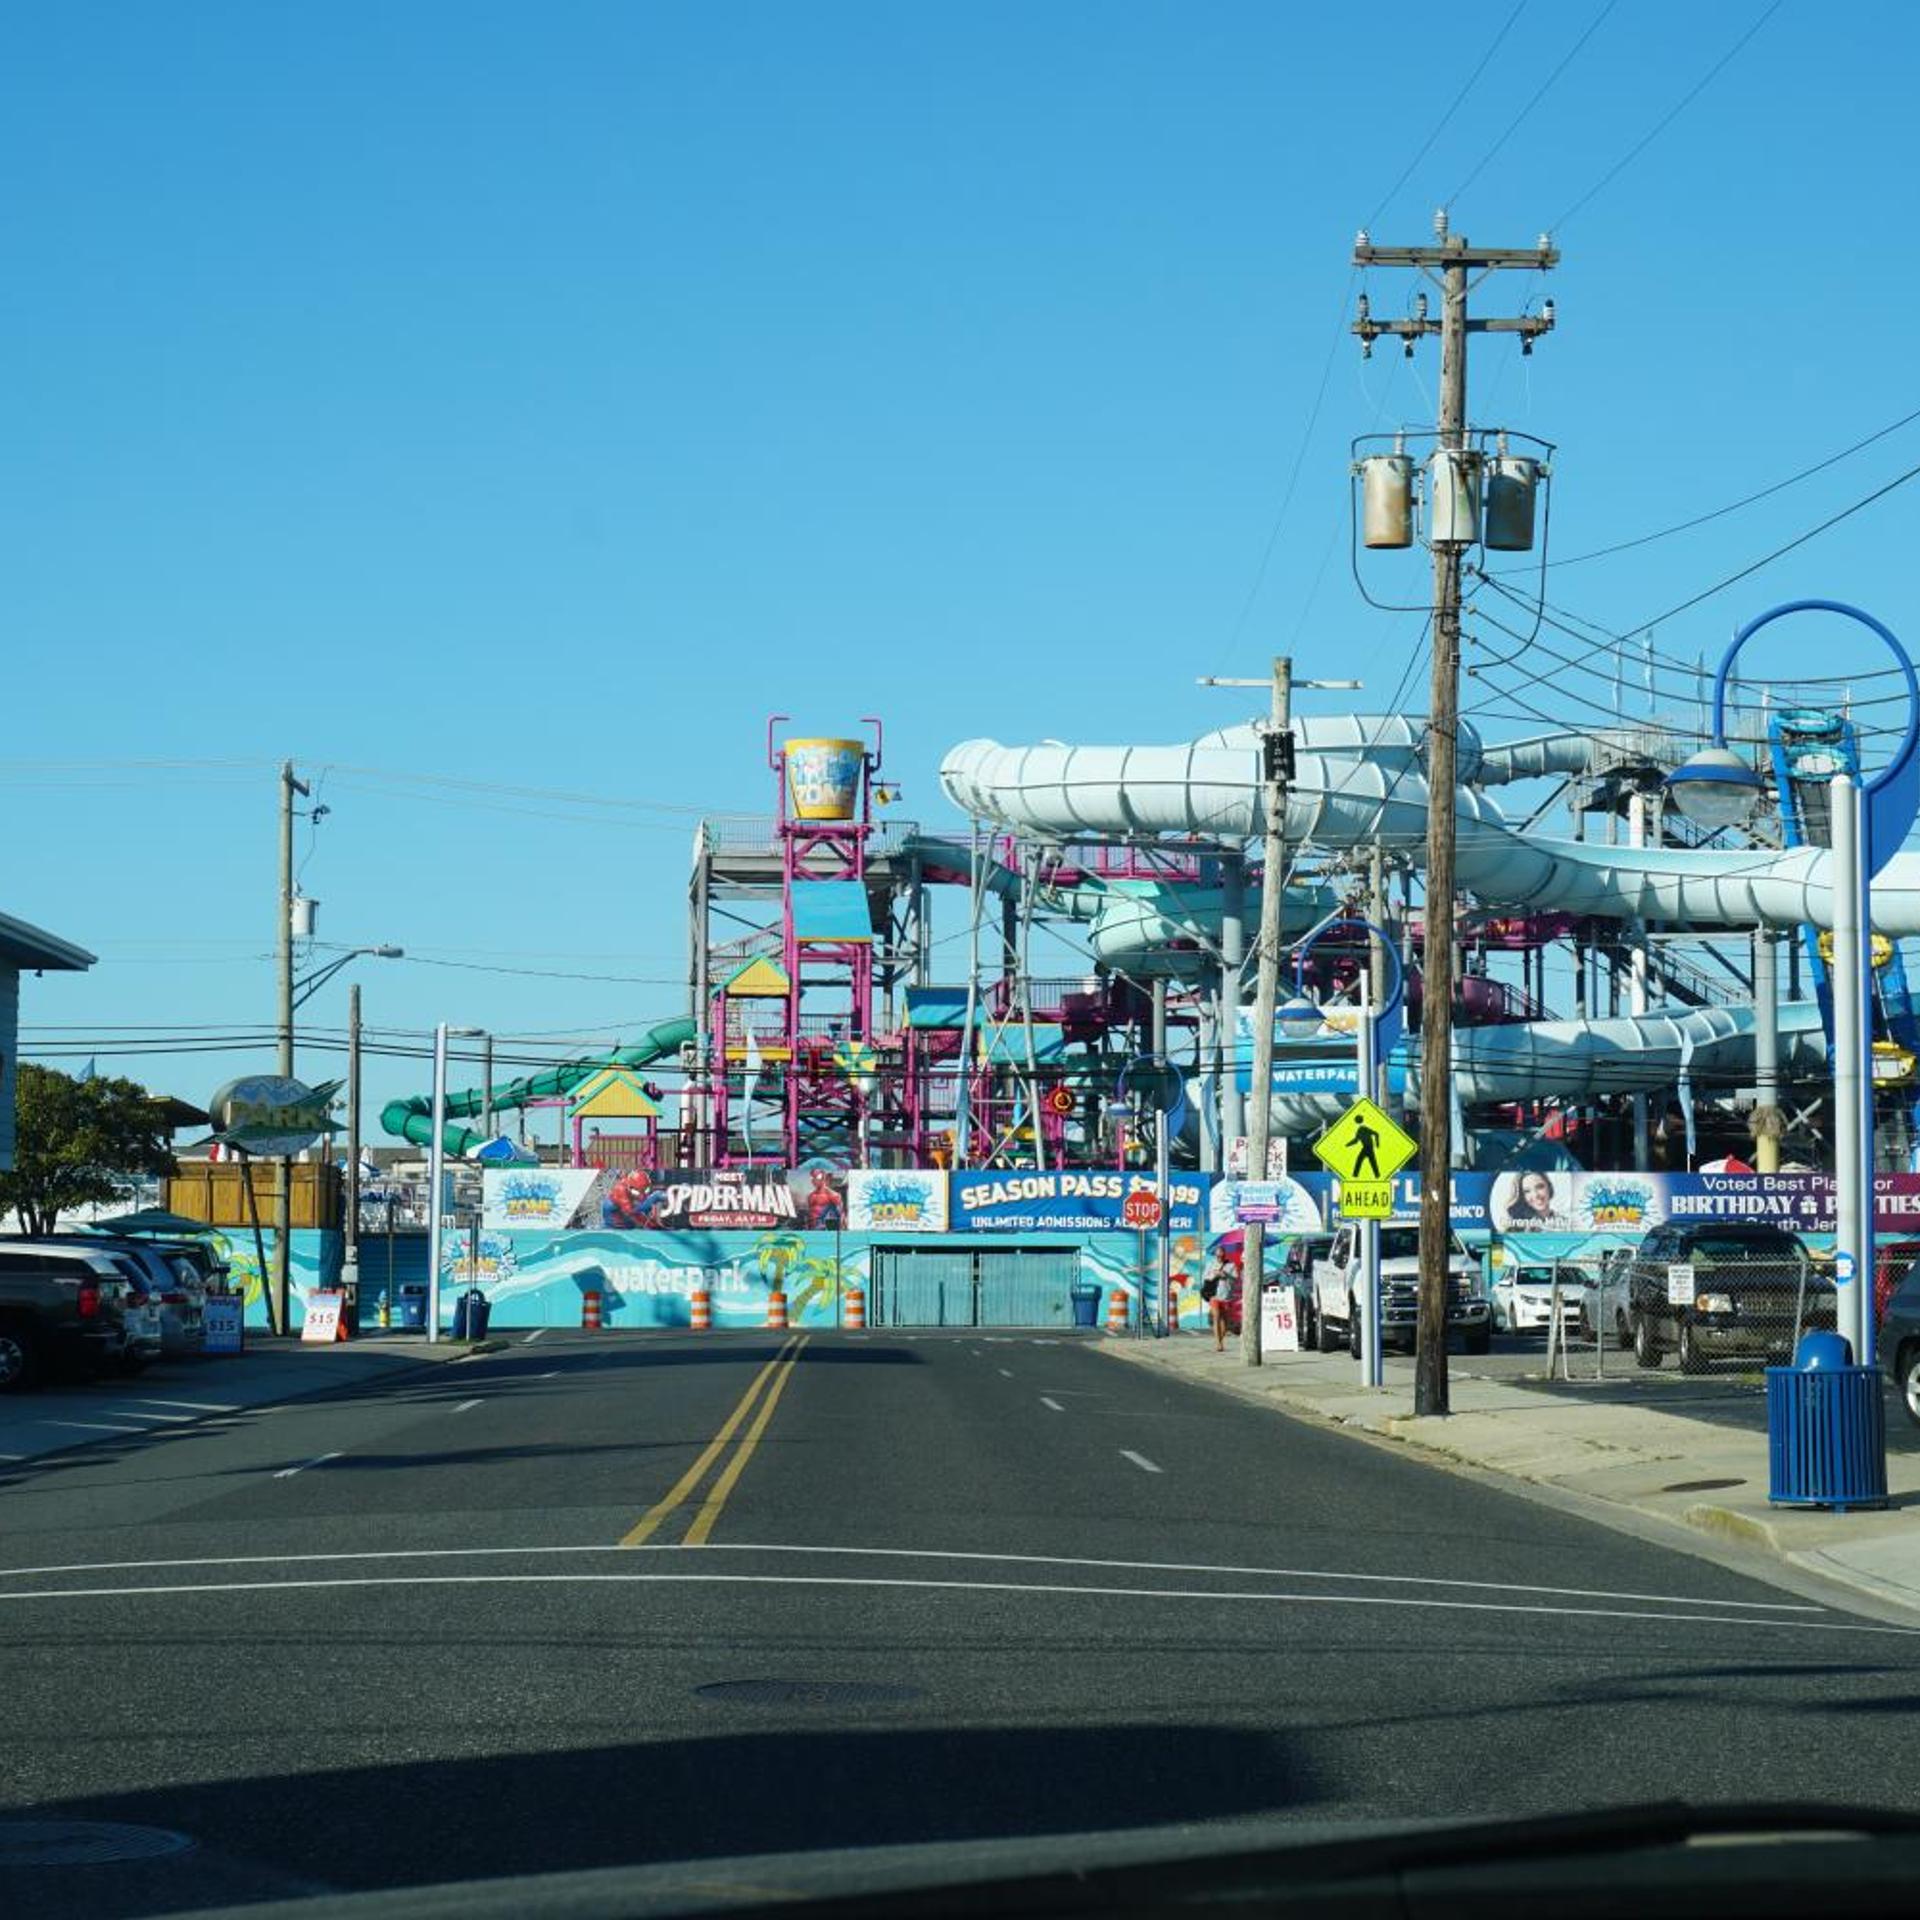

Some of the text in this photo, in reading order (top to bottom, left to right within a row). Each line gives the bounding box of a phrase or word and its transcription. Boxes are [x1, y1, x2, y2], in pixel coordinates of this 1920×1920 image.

[1273, 1069, 1357, 1082] WATERPAR
[714, 1172, 745, 1182] MEET
[1702, 1176, 1893, 1191] Voted Best Pla or
[961, 1175, 1056, 1211] SEASON
[1060, 1174, 1123, 1198] PASS
[1344, 1190, 1389, 1208] AHEAD
[660, 1183, 797, 1219] SPIDER-MAN
[1671, 1195, 1920, 1215] BIRTHDAY PTIES
[872, 1203, 921, 1221] ZONE
[1126, 1202, 1160, 1218] STOP
[1593, 1207, 1643, 1224] ZONE
[971, 1216, 1034, 1228] UNLIMITED
[1036, 1216, 1111, 1228] ADMISSIONS
[1807, 1217, 1838, 1232] Jer
[308, 1312, 334, 1324] $15
[209, 1320, 236, 1332] $15
